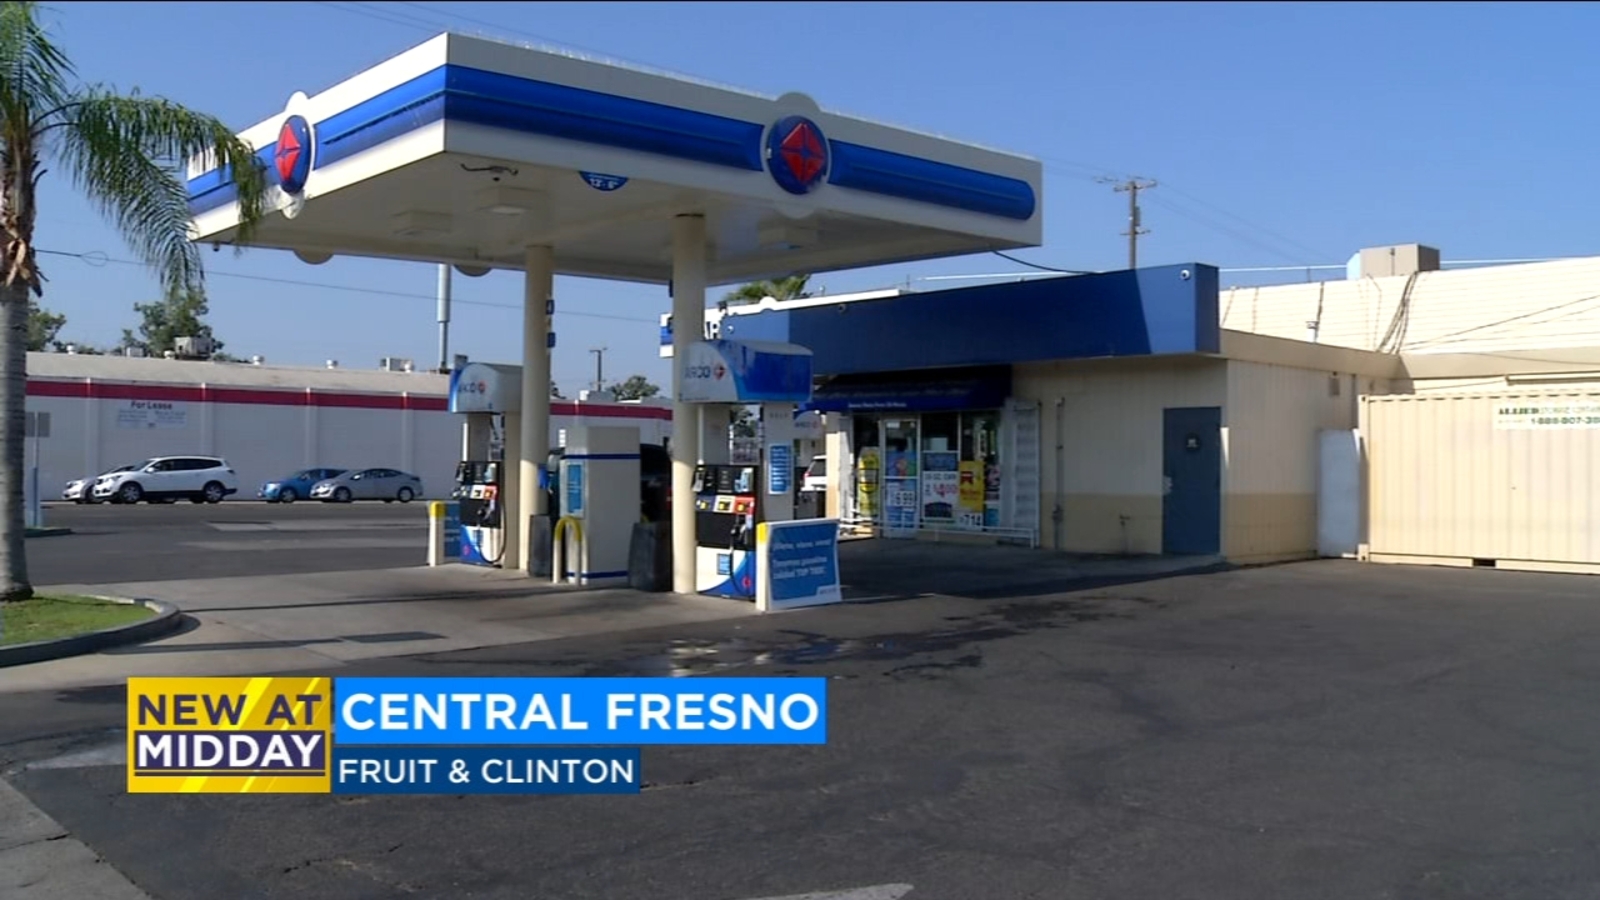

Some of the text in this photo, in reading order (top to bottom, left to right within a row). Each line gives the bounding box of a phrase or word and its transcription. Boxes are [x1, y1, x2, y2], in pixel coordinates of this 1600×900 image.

[130, 401, 172, 410] For Lease
[1498, 407, 1540, 415] ALLIED
